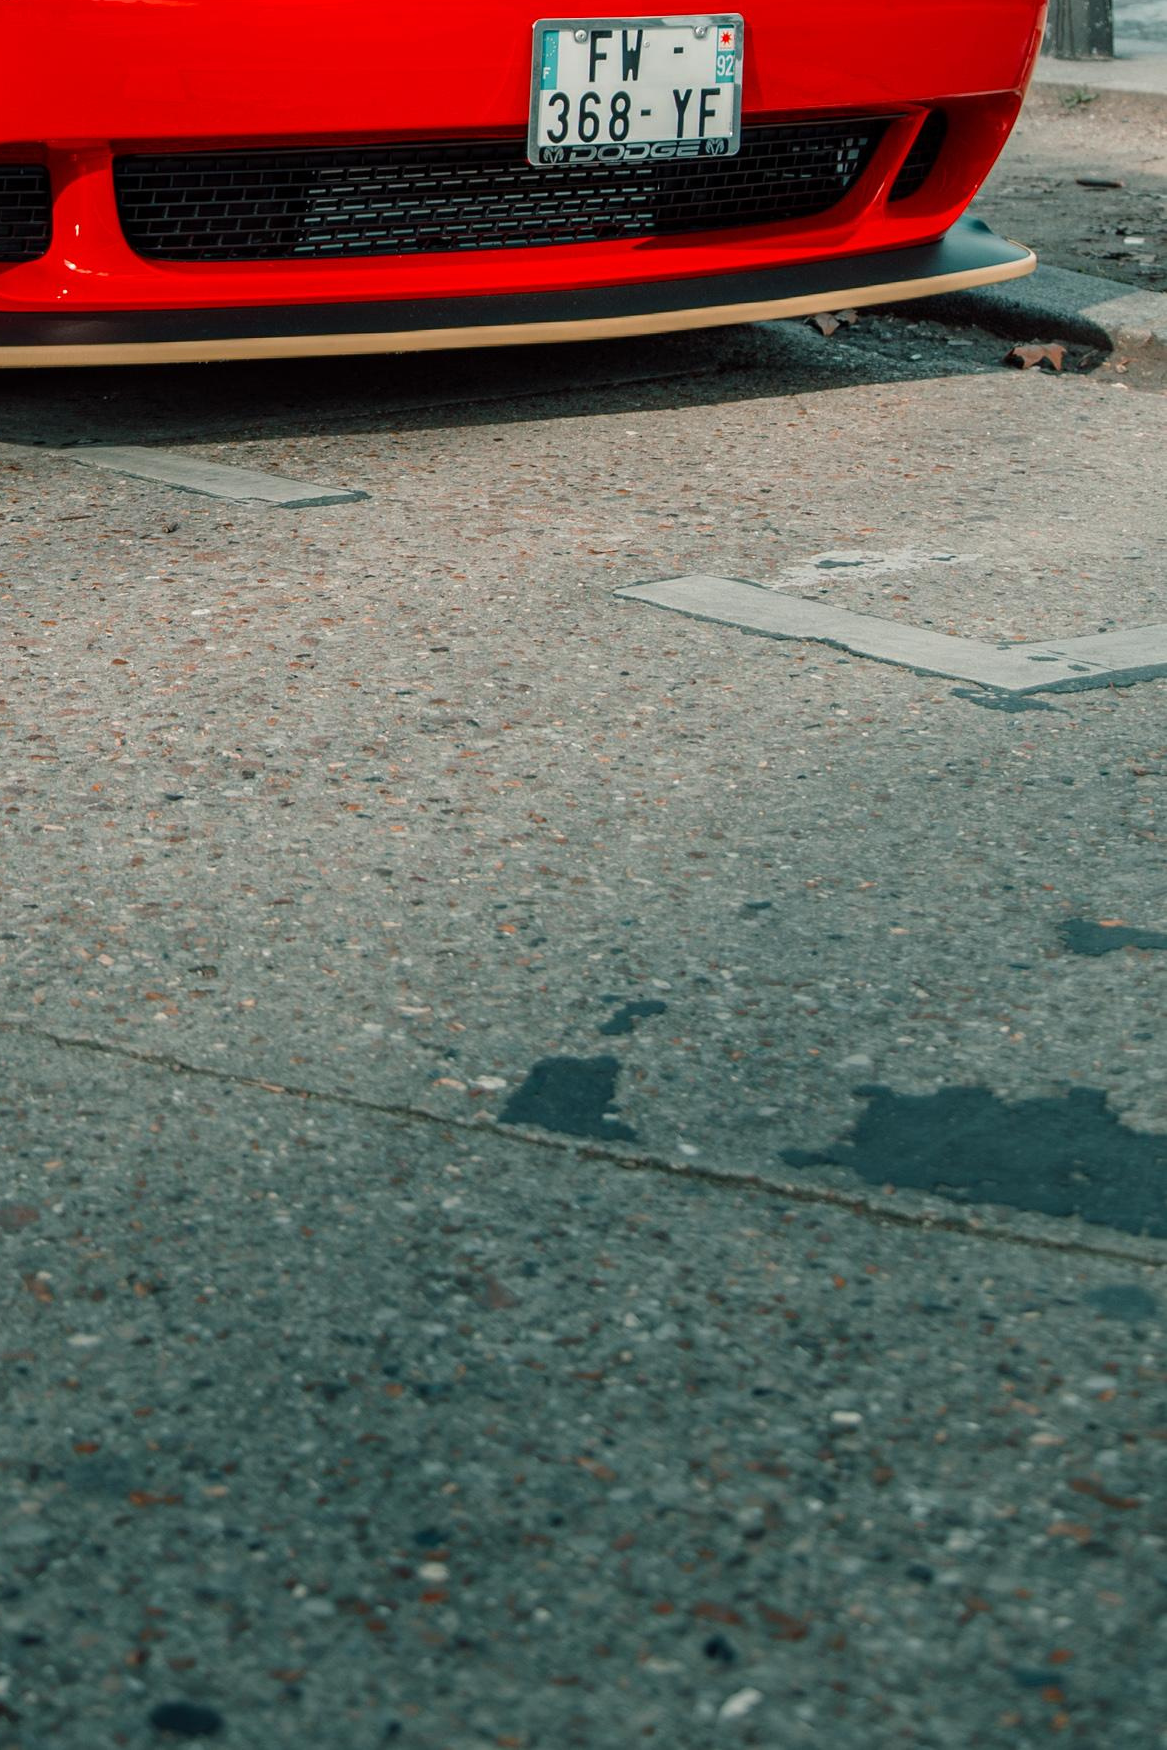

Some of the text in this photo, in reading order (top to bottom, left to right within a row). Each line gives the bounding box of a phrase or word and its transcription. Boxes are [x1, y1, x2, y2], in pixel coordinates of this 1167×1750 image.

[589, 29, 643, 82] FW
[716, 54, 734, 77] 92
[542, 66, 551, 80] F
[569, 137, 701, 162] DODGE
